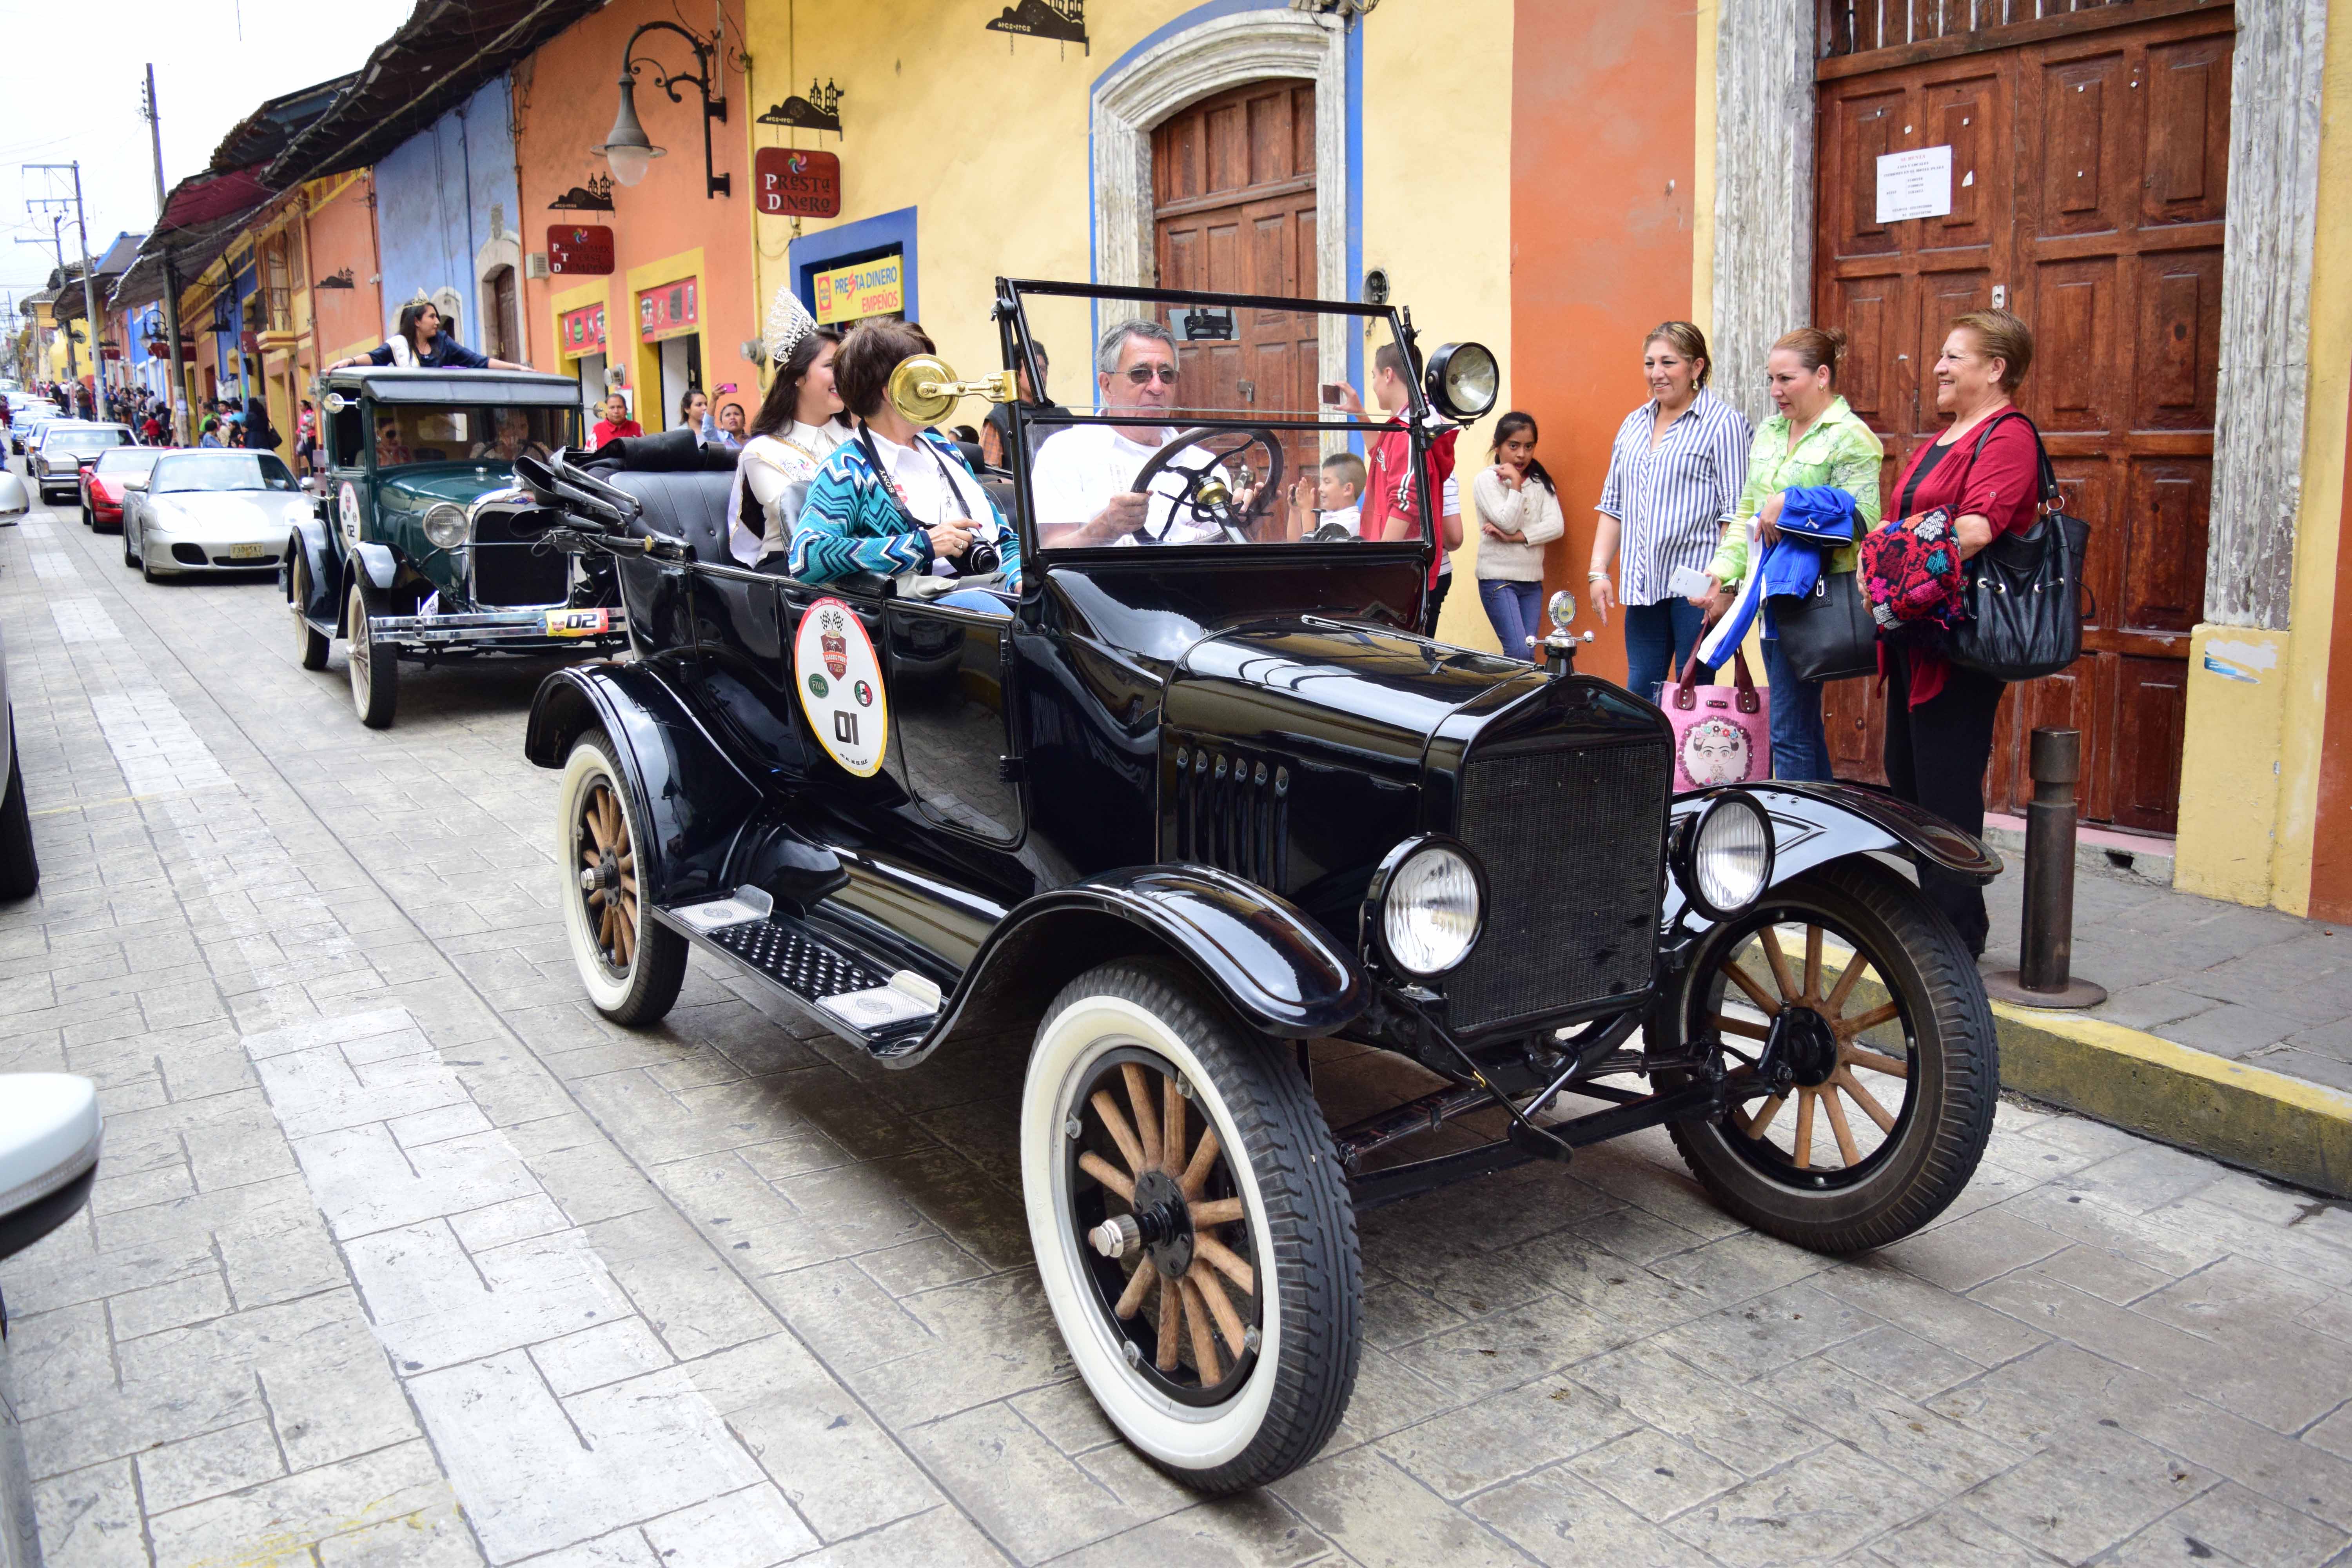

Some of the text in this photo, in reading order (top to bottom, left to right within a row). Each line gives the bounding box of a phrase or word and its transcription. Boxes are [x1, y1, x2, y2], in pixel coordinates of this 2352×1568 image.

[835, 269, 865, 305] PRESTA
[866, 266, 897, 289] DINERO
[862, 290, 898, 313] EMPEÑOS
[879, 469, 895, 493] SONY
[347, 525, 355, 537] 02
[566, 614, 597, 629] 02
[812, 680, 825, 691] FIVA
[834, 710, 859, 746] 01
